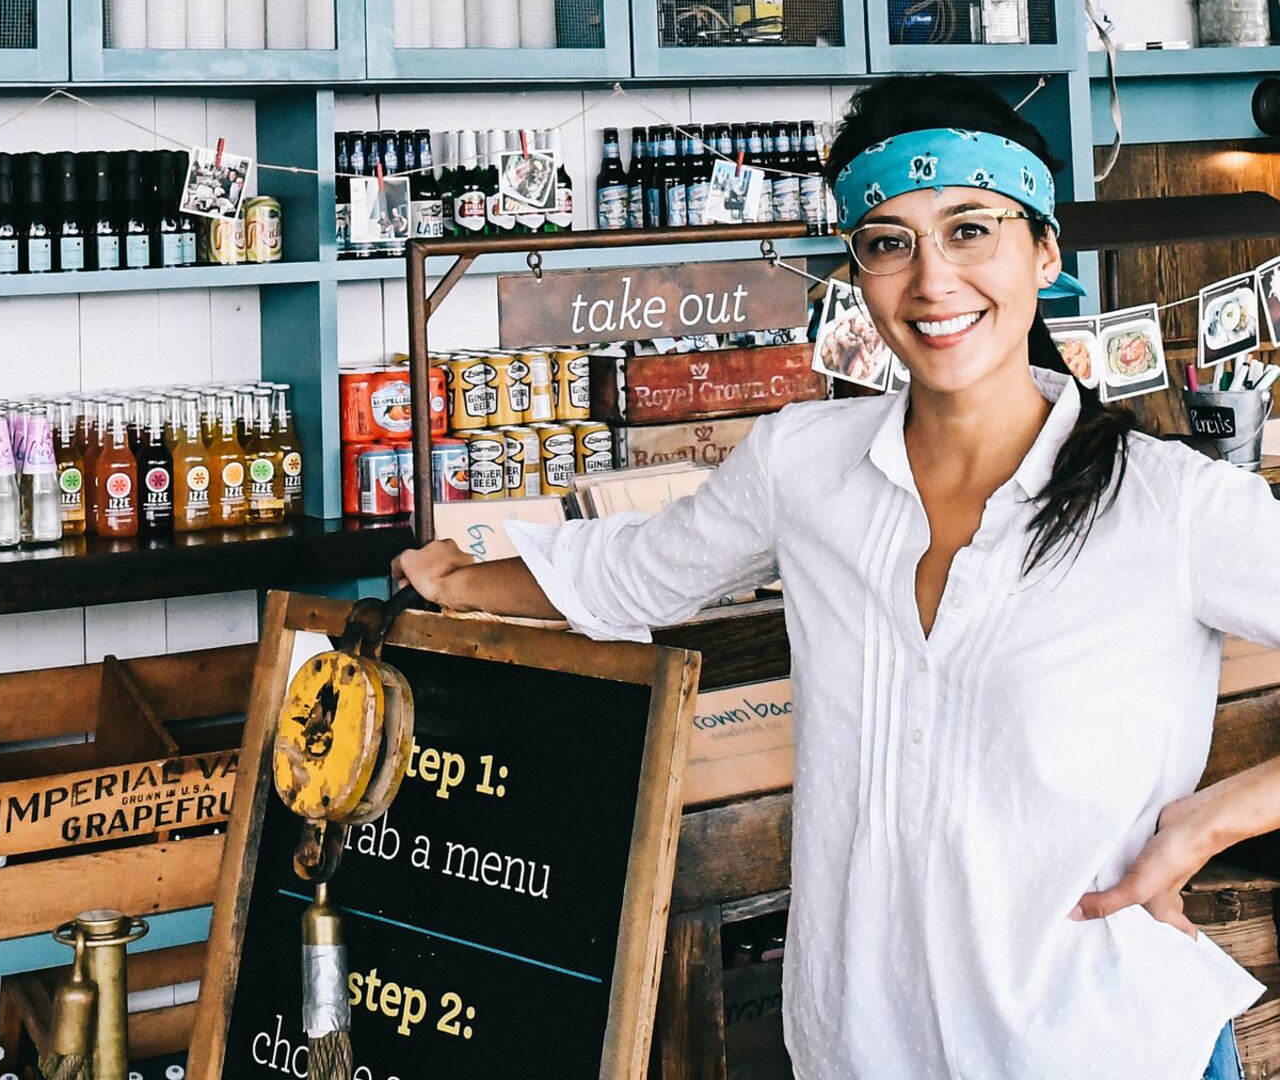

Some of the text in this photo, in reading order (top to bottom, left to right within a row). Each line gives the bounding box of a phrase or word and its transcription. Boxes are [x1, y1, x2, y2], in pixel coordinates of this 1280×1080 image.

[571, 278, 749, 335] take out
[1190, 409, 1234, 435] Pencils
[252, 482, 272, 493] IZZE
[286, 476, 301, 487] IZZE
[148, 492, 168, 503] IZZE
[189, 490, 208, 502] IZZE
[224, 486, 243, 497] IZZE
[62, 492, 81, 504] IZZE
[109, 498, 131, 509] IZZE
[407, 741, 510, 799] tep 1:
[121, 792, 161, 806] GROWN
[181, 783, 214, 796] U.S.A.
[412, 832, 431, 870] a
[441, 836, 552, 900] menu
[348, 968, 476, 1039] step 2:
